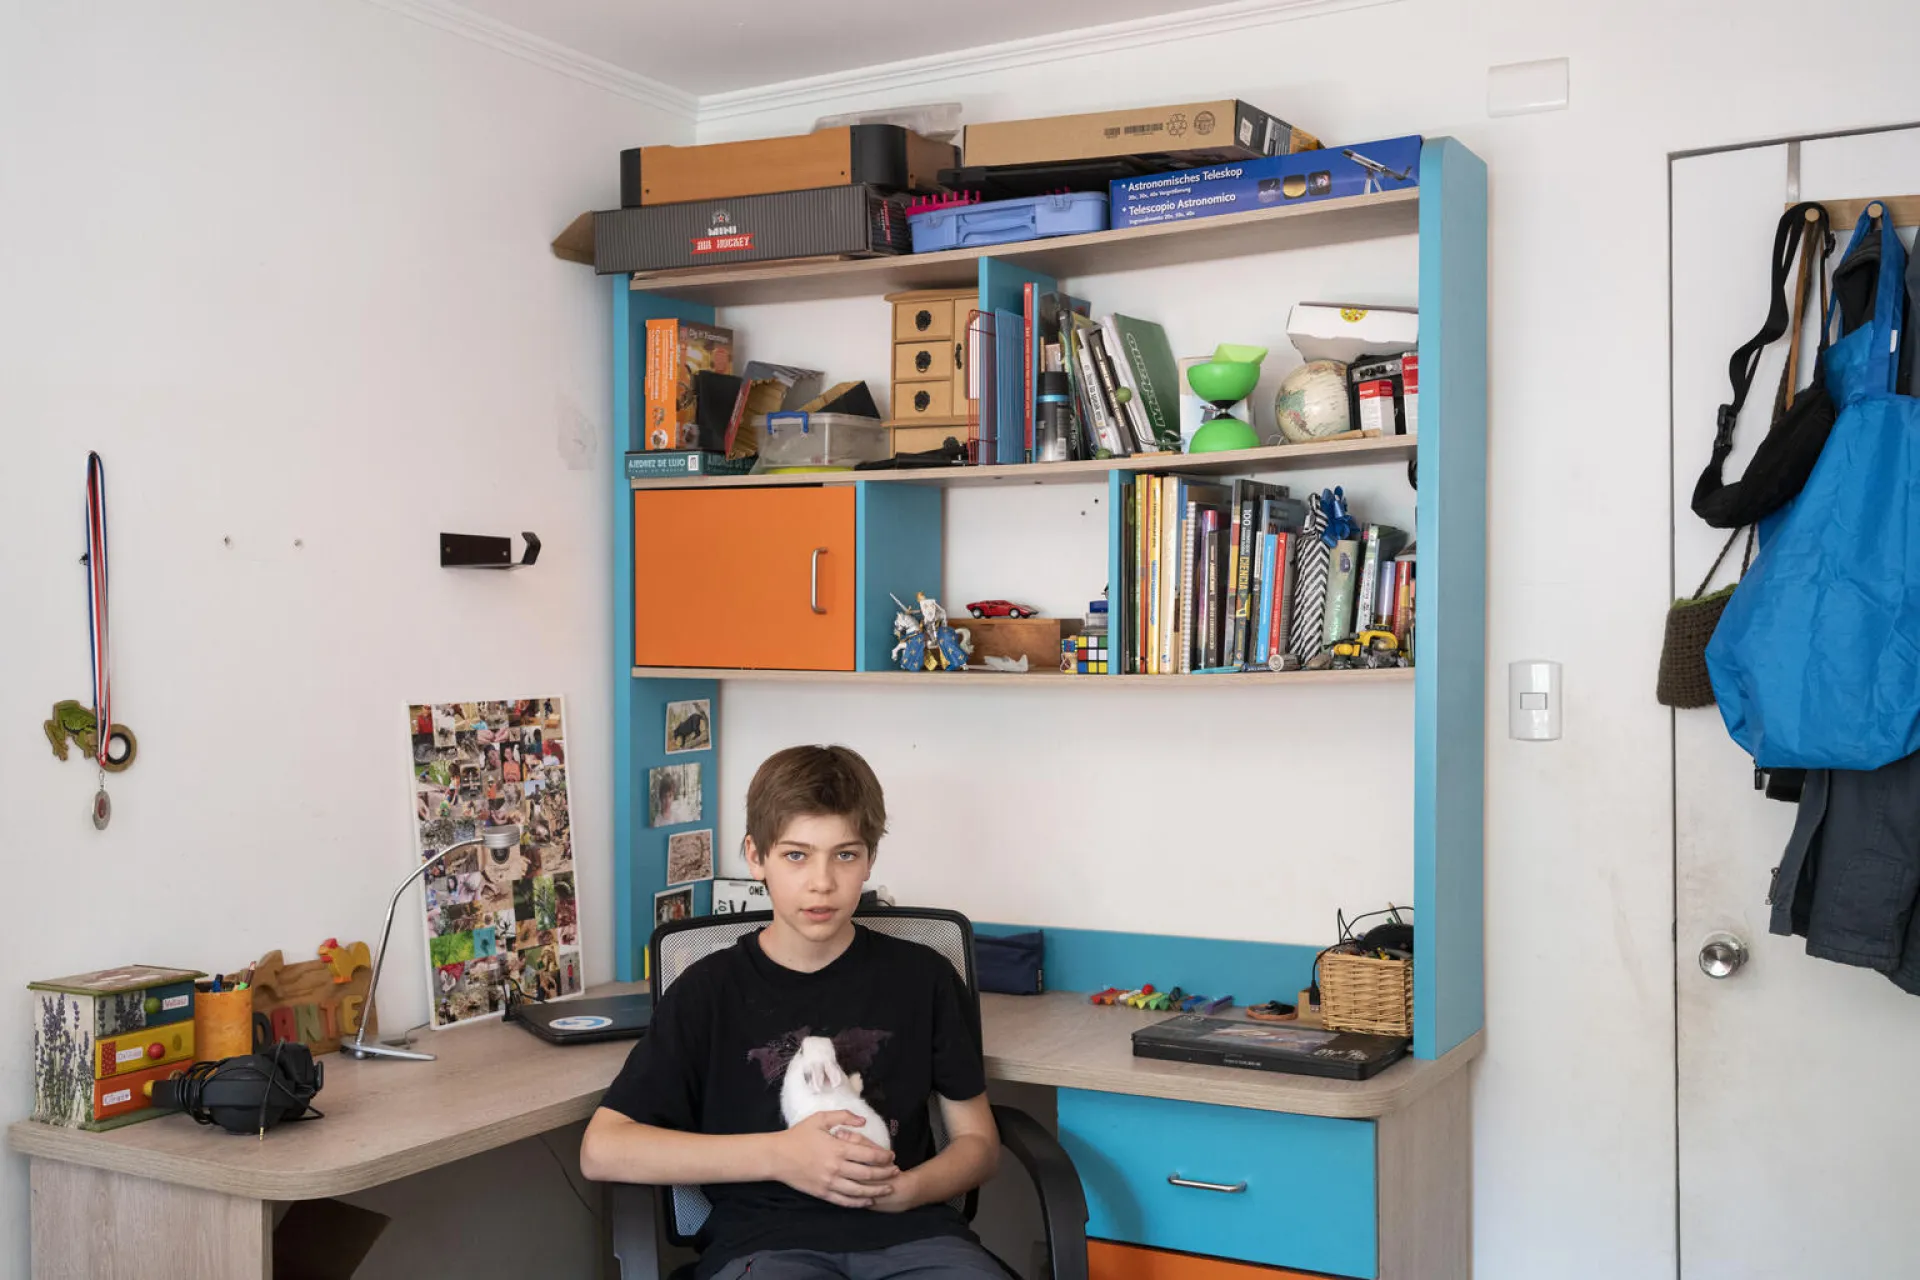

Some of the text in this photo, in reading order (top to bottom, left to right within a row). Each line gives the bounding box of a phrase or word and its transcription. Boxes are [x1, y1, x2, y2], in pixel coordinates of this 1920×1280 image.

[1128, 166, 1243, 192] Astronomisches Teleskop
[1128, 192, 1236, 216] Telescopio Astronomico
[707, 226, 737, 236] MINI
[716, 236, 750, 249] HOCKEY
[628, 458, 686, 469] AJEDREZ DE LUJO
[1242, 509, 1252, 526] 100
[1239, 556, 1250, 591] CIENCIA
[749, 886, 764, 896] ONE
[252, 994, 363, 1053] DANTE
